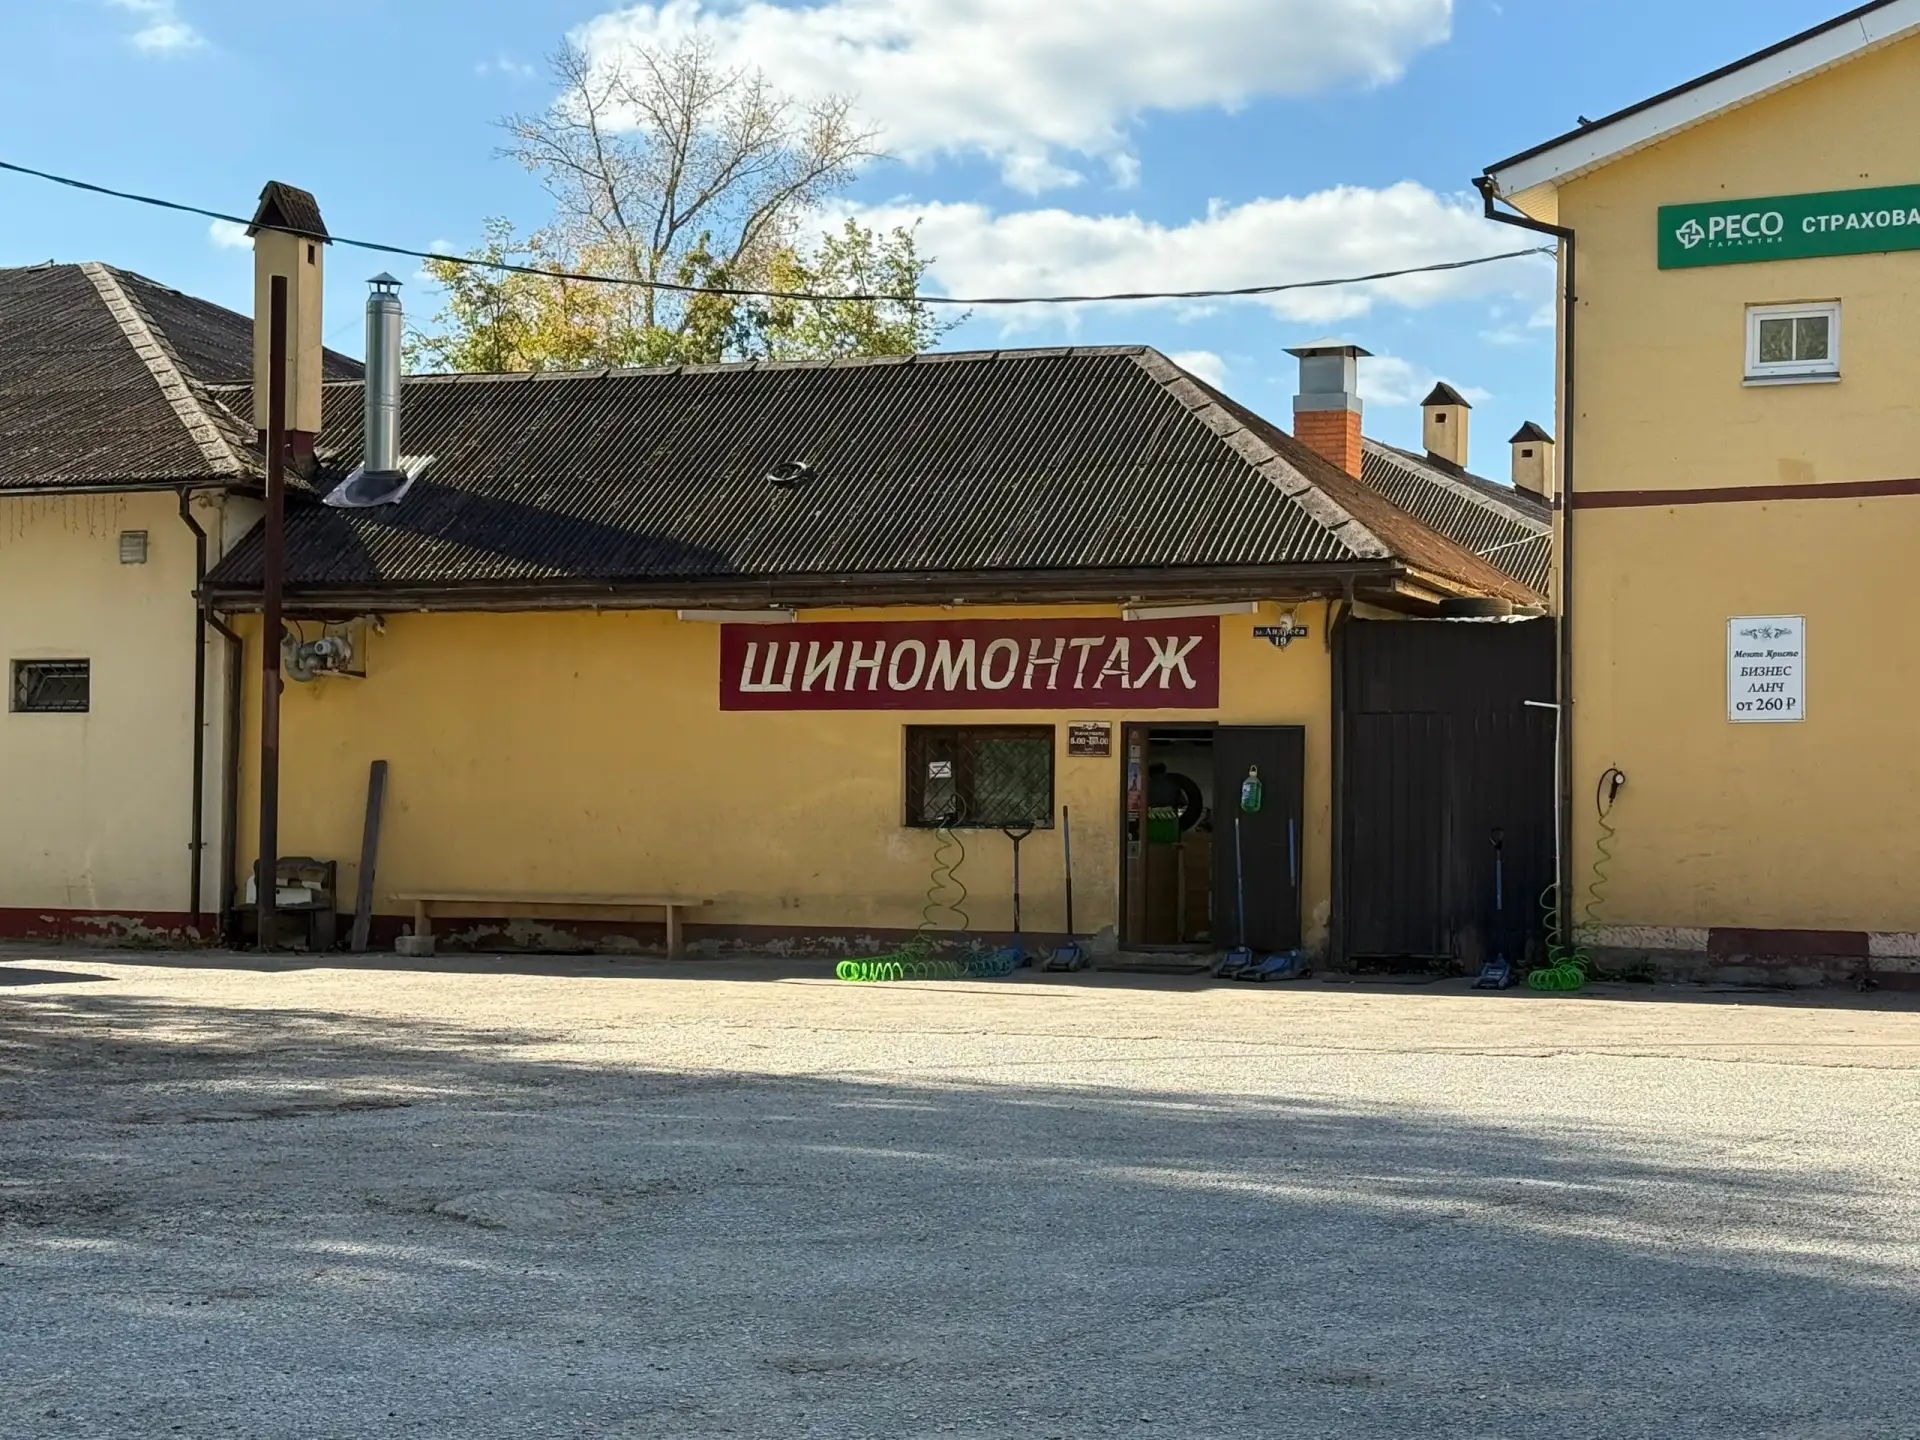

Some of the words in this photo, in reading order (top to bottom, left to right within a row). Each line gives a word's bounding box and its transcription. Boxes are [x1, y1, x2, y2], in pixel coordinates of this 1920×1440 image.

[1709, 211, 1784, 240] РЕСО
[1802, 208, 1920, 233] СТРАХОВА
[1708, 236, 1783, 248] ГАРАНТИЯ
[1275, 636, 1287, 646] 19
[739, 635, 1203, 693] ШИНОМОНТАЖ
[1740, 666, 1792, 677] БИЗНЕС
[1747, 682, 1785, 693] ЛАНЧ
[1736, 702, 1753, 711] от
[1756, 697, 1783, 711] 260
